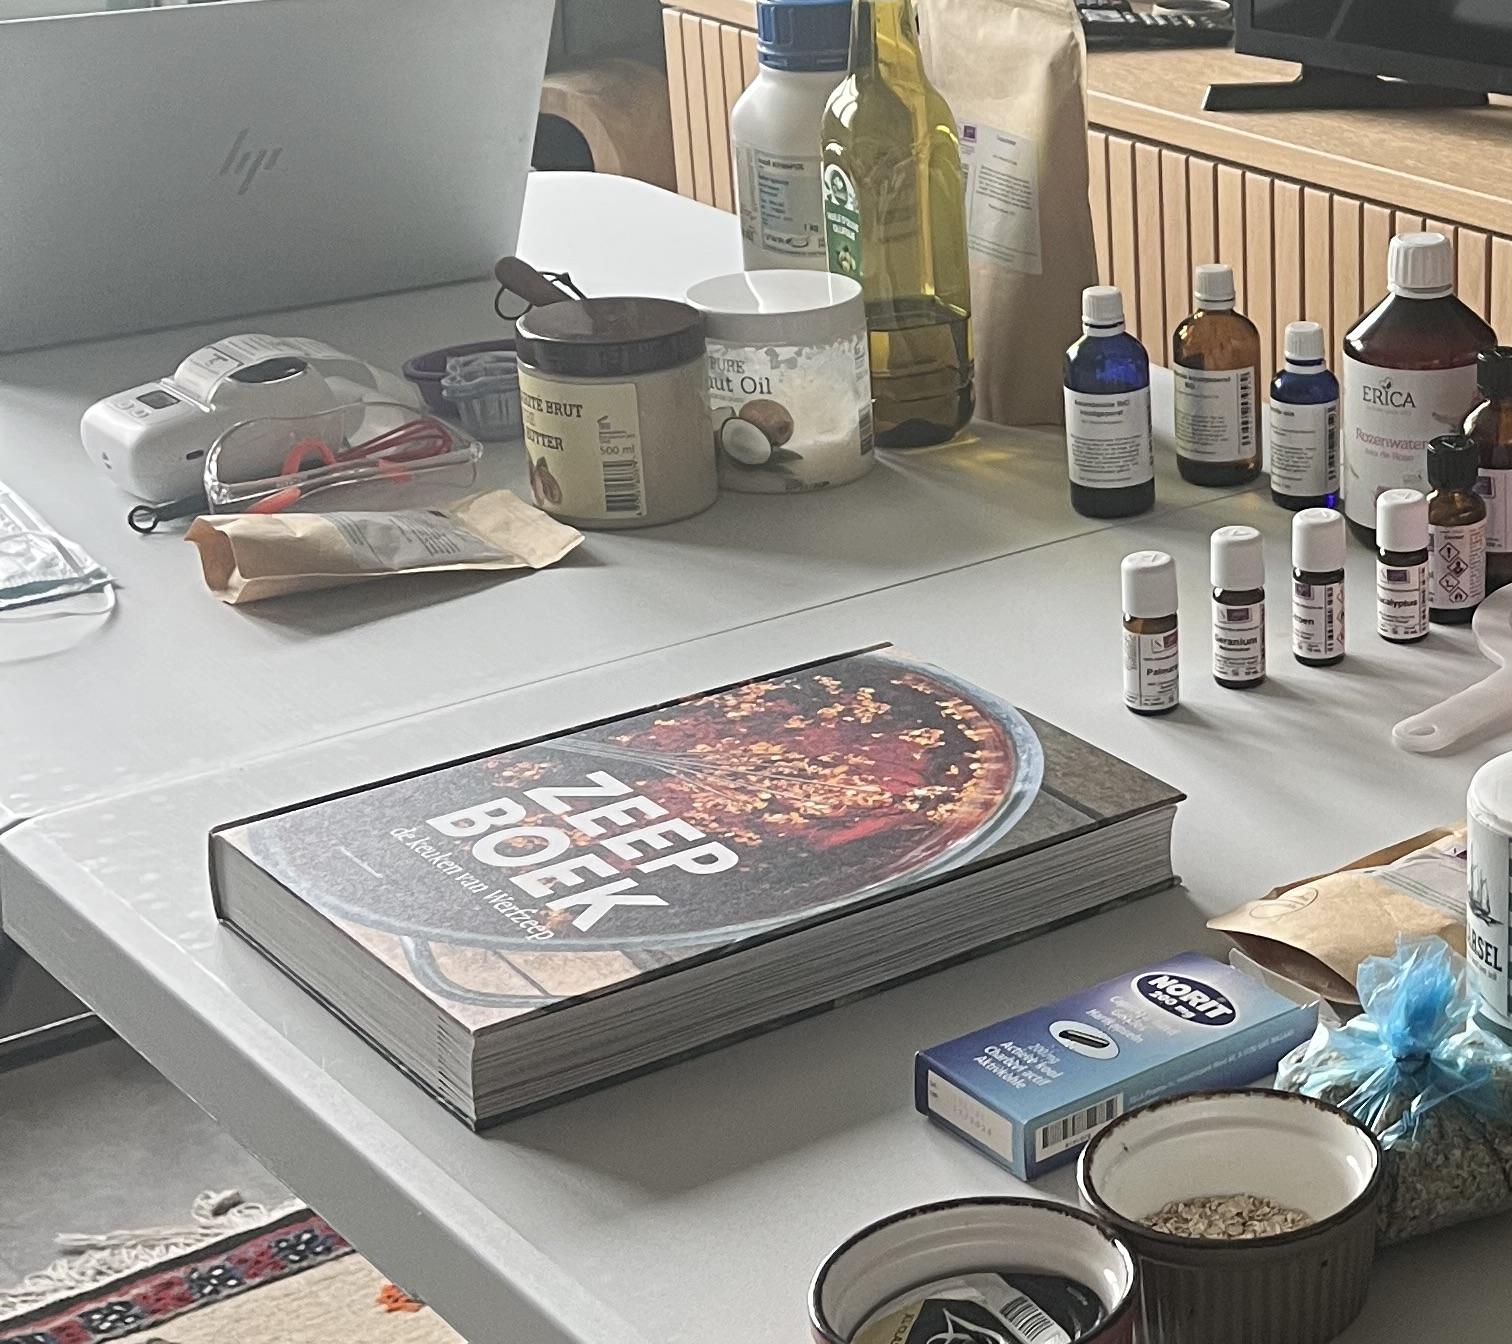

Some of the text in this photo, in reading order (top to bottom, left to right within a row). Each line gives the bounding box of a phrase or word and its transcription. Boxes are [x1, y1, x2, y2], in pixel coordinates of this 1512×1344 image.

[219, 127, 283, 196] hp
[708, 355, 746, 374] PURE
[740, 375, 773, 395] Oil
[1362, 386, 1417, 408] ERICA
[545, 400, 584, 418] BRUT
[1356, 427, 1428, 450] Rozenwater
[600, 445, 620, 455] 500
[1378, 596, 1418, 609] ucalyptus
[1146, 663, 1179, 676] Palmar
[523, 770, 740, 875] ZEEP
[425, 797, 670, 933] BOEK
[389, 826, 411, 842] de
[406, 830, 464, 876] keuken
[454, 869, 489, 895] van
[482, 888, 556, 942] Werfzeep
[1148, 975, 1233, 1019] NORIT
[1148, 990, 1196, 1019] 200 mg
